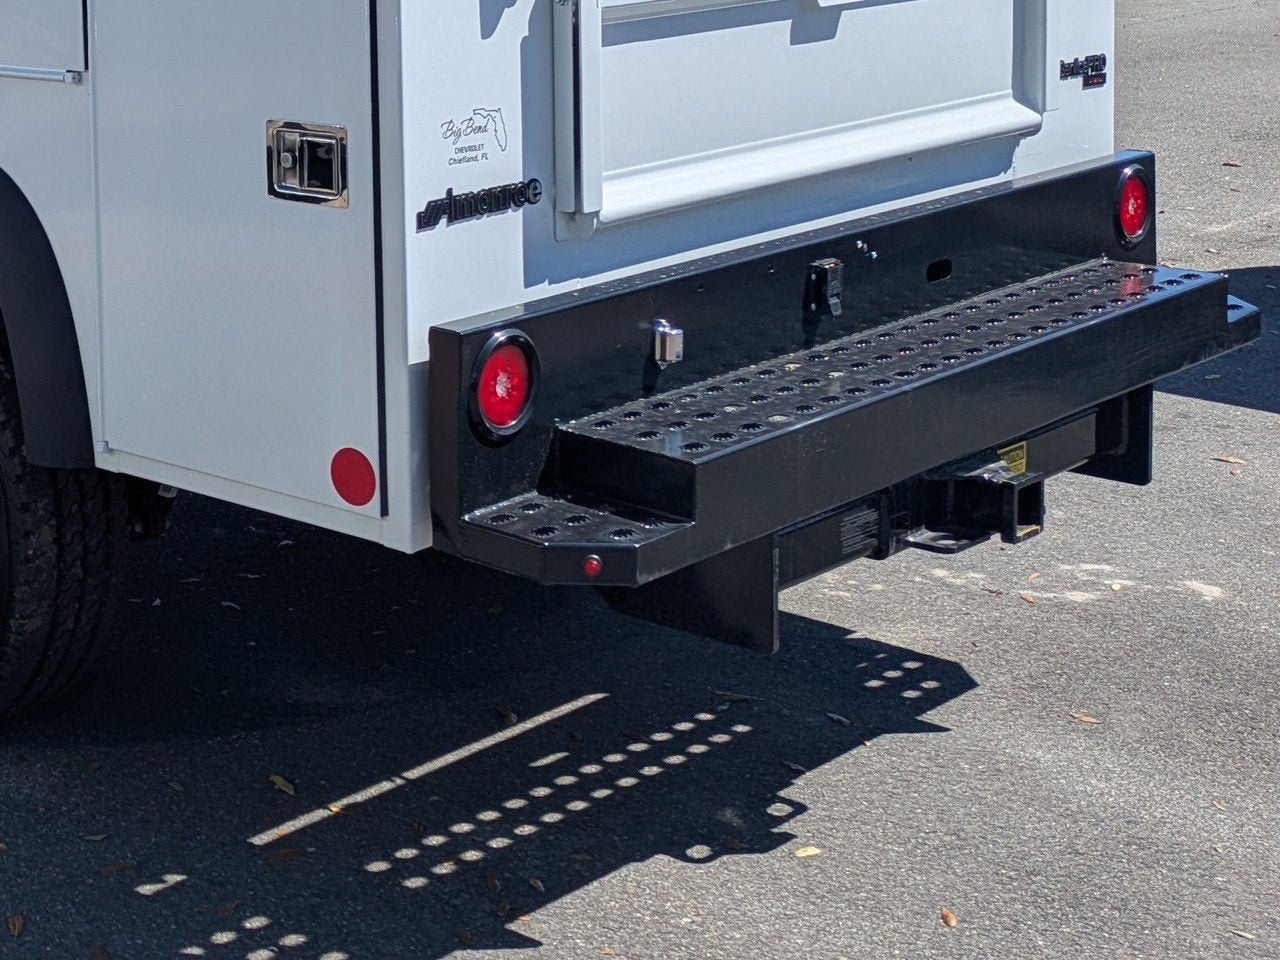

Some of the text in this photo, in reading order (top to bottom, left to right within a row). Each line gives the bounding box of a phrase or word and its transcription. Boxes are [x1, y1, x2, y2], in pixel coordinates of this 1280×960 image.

[440, 116, 490, 145] Big Bend
[454, 143, 485, 154] CHEVROLET
[448, 153, 489, 166] Chiefland, FL
